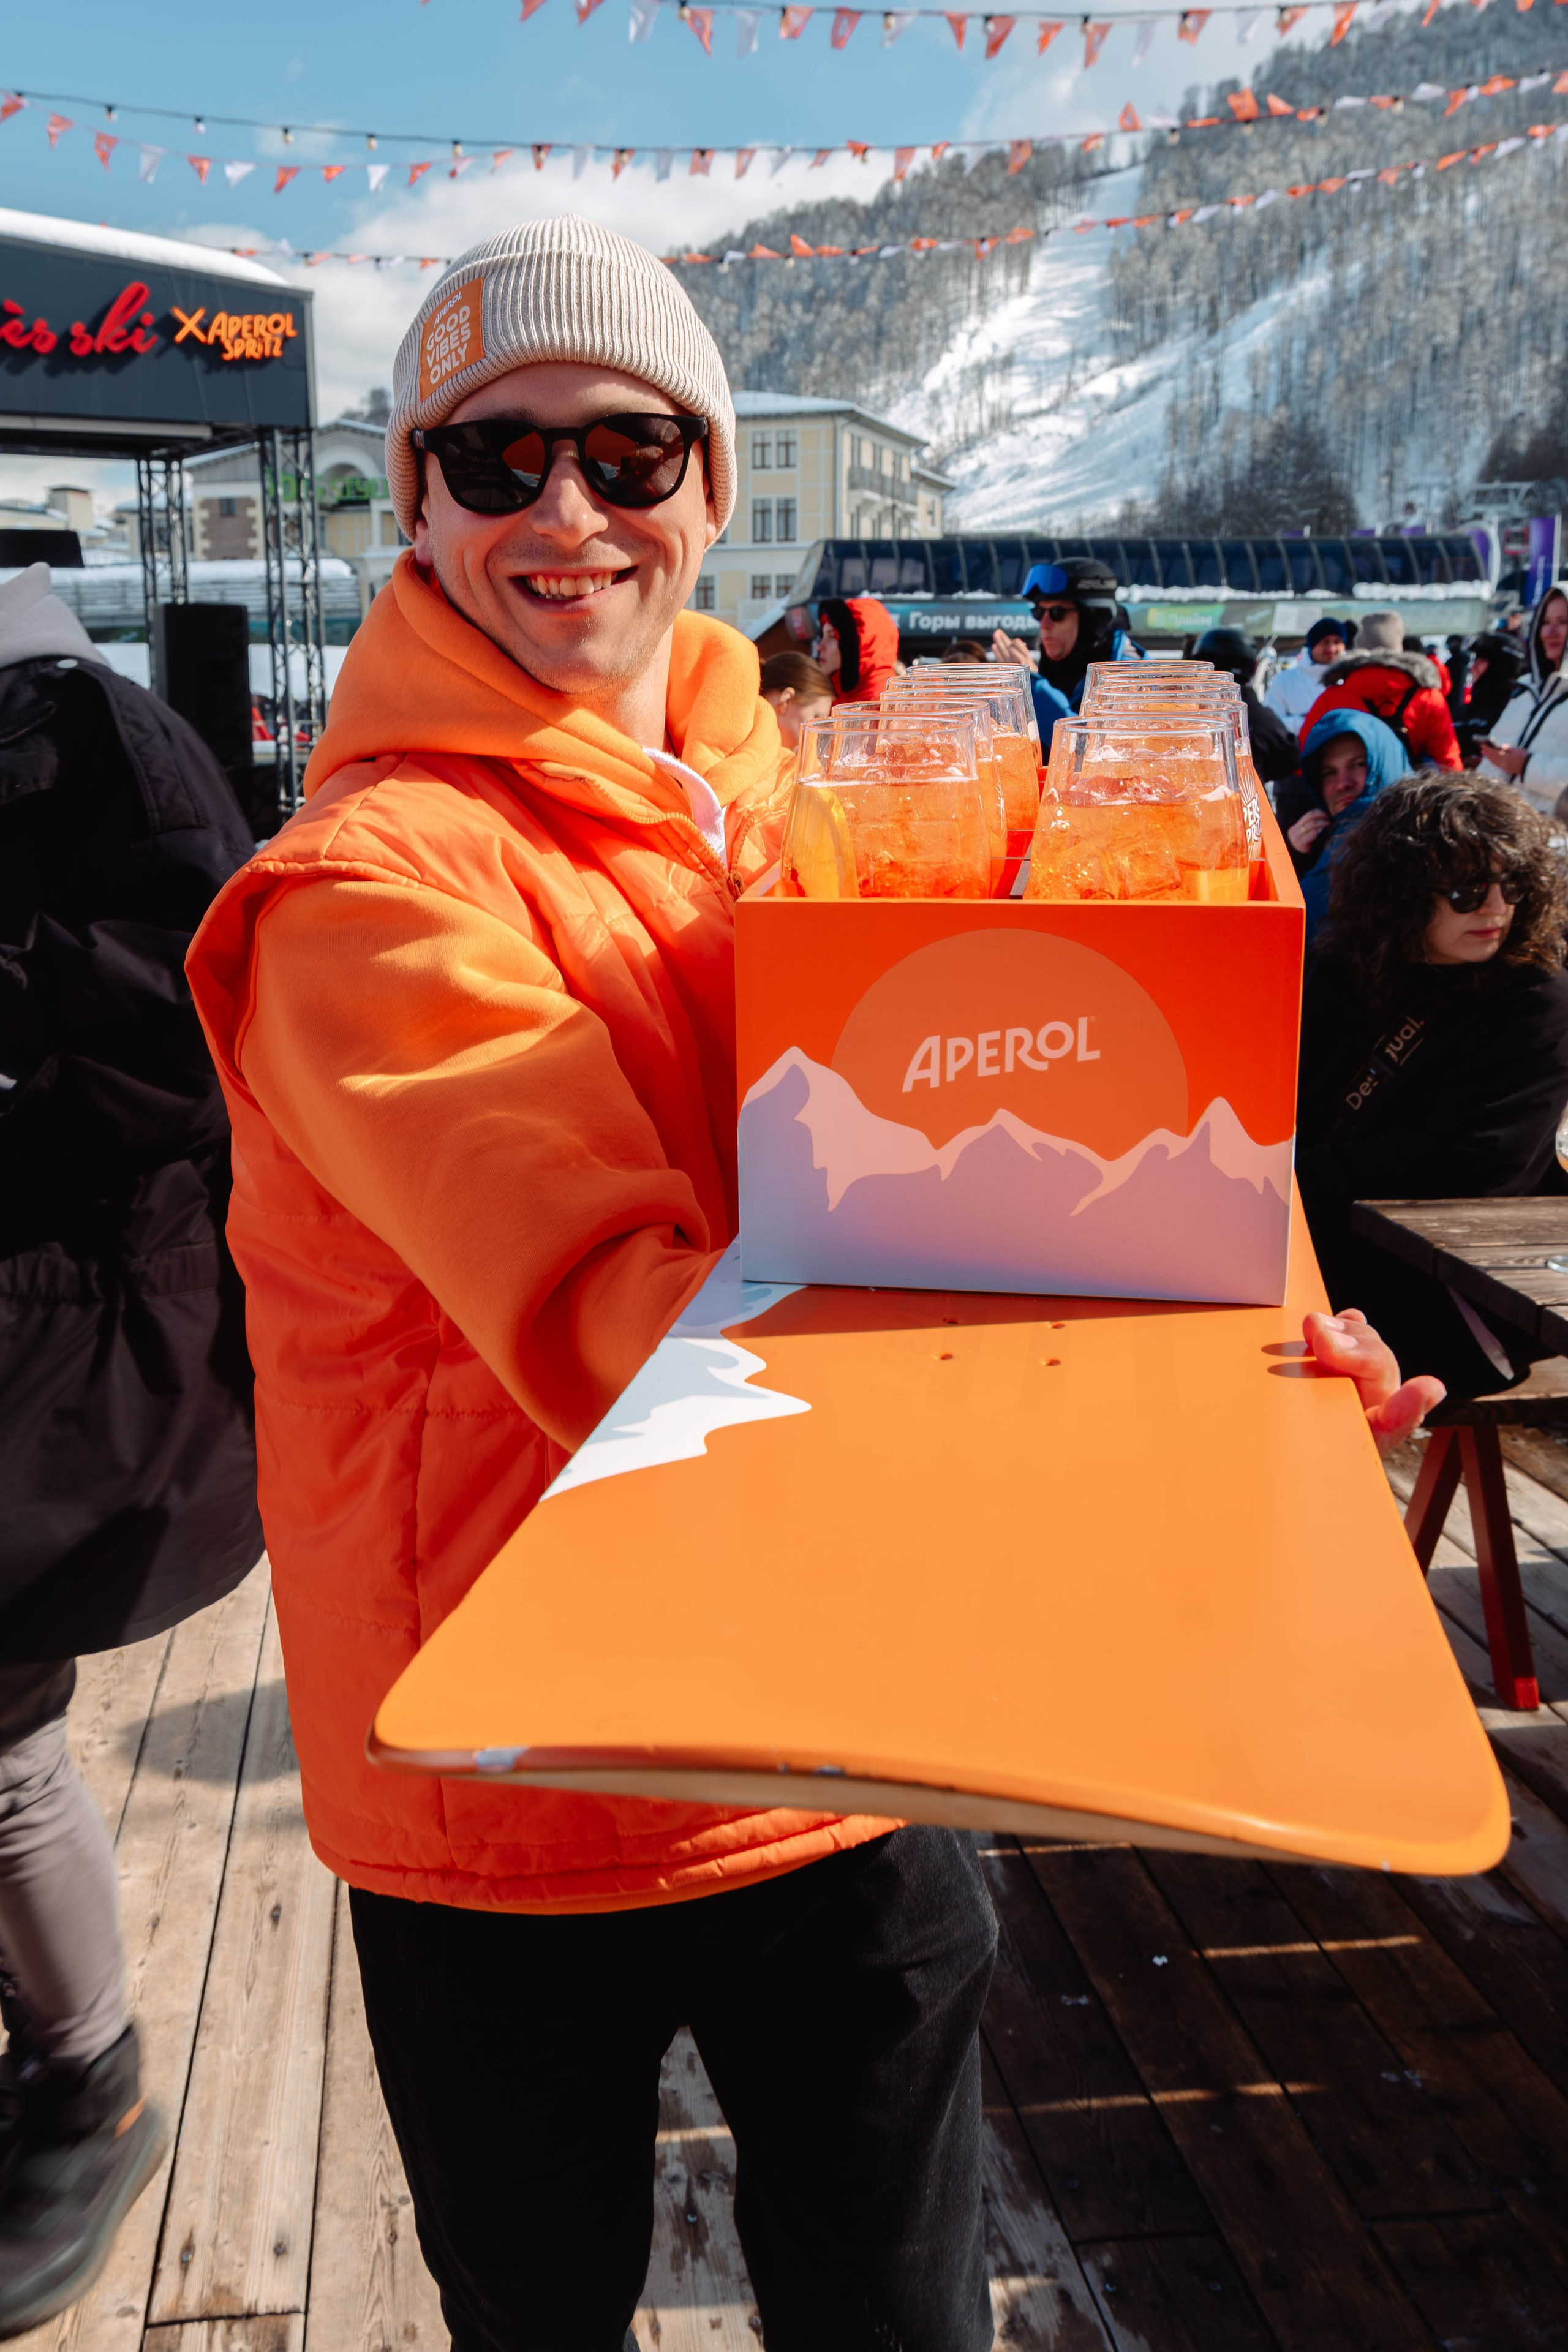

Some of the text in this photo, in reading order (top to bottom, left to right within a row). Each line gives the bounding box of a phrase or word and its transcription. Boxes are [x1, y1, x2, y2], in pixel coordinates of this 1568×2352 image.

[69, 281, 157, 356] ski
[207, 311, 298, 345] APEROL
[426, 305, 470, 351] GOOD
[433, 290, 462, 328] APEROL
[426, 322, 471, 368] VIBES
[429, 343, 467, 385] ONLY
[908, 611, 961, 633] Горы
[902, 1017, 1101, 1093] APEROL
